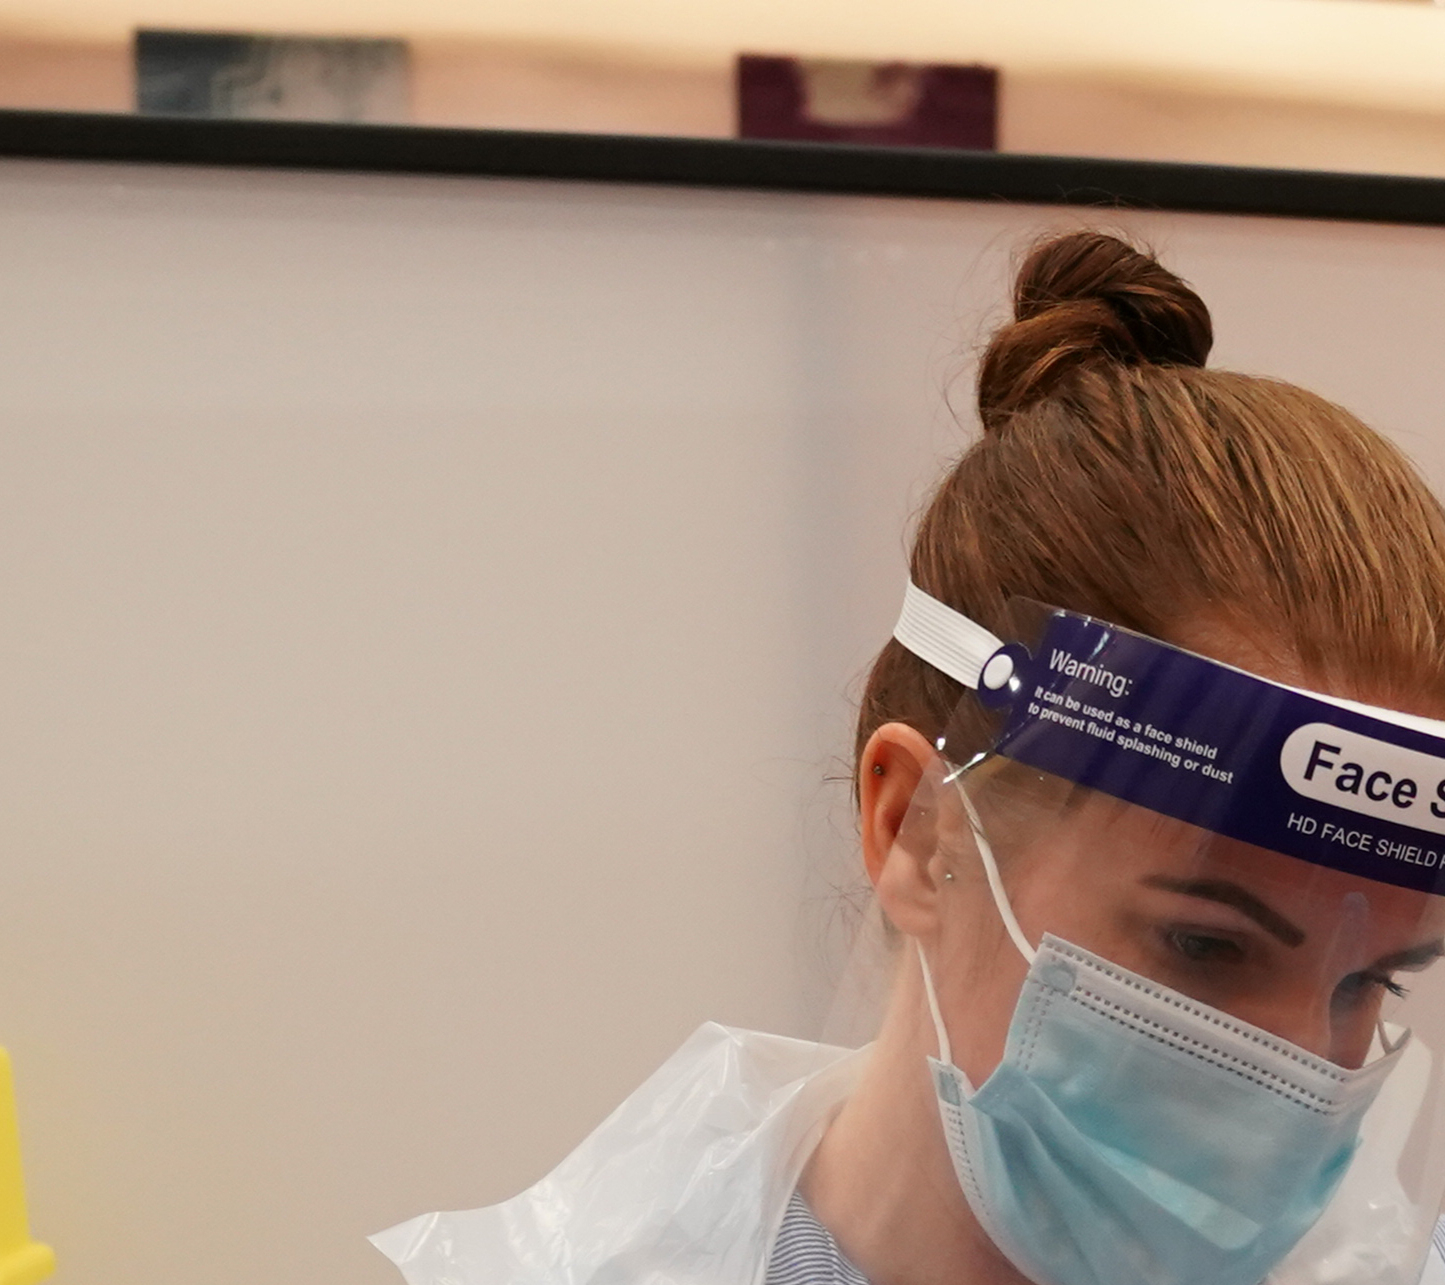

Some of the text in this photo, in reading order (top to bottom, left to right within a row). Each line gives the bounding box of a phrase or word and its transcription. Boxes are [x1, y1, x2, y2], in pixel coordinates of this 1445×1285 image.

[1048, 648, 1133, 698] Warning:
[1028, 702, 1234, 785] to prevent fluid splashing or dust
[1034, 685, 1218, 760] It can be used as a face shield
[1303, 740, 1418, 809] Face
[1286, 812, 1317, 835] HD
[1320, 824, 1374, 852] FACE
[1375, 838, 1437, 867] SHIELD
